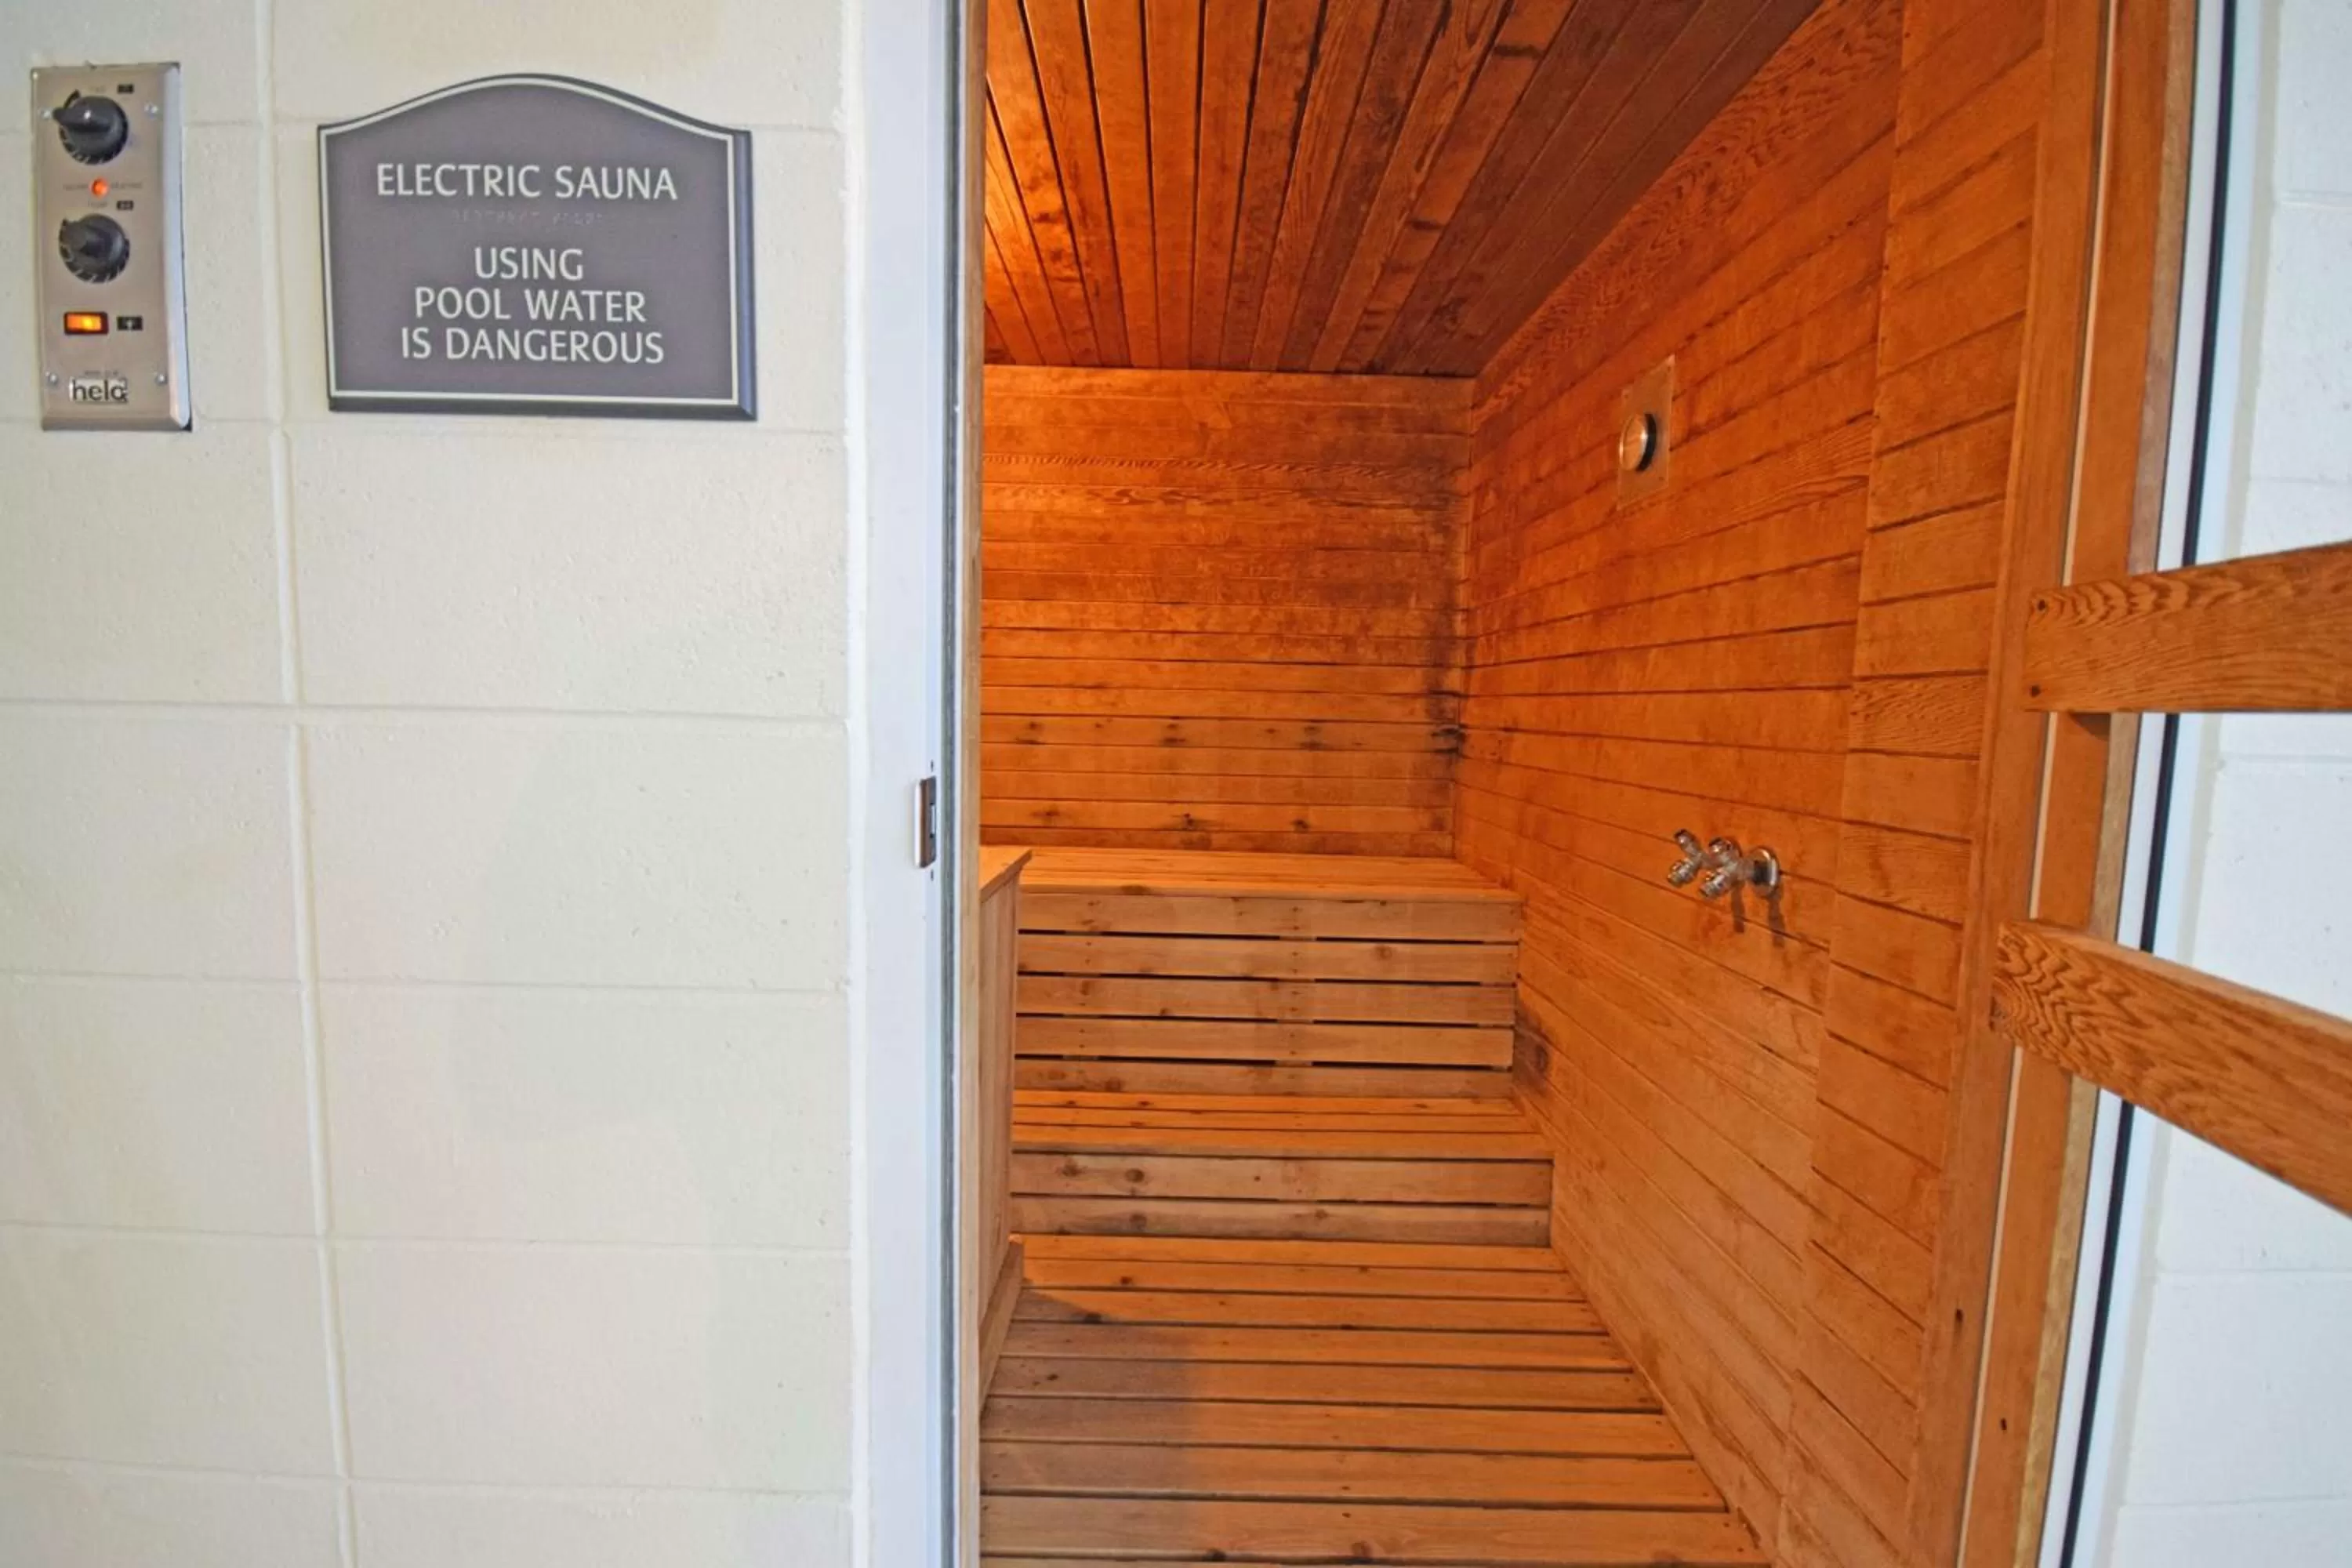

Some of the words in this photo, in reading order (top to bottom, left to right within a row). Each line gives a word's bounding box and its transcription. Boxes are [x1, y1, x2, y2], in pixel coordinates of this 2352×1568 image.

[377, 163, 541, 198] ELECTRIC
[555, 165, 679, 200] SAUNA
[474, 247, 583, 281] USING
[416, 286, 511, 319] POOL
[524, 289, 646, 322] WATER
[401, 327, 431, 359] IS
[446, 328, 664, 364] DANGEROUS
